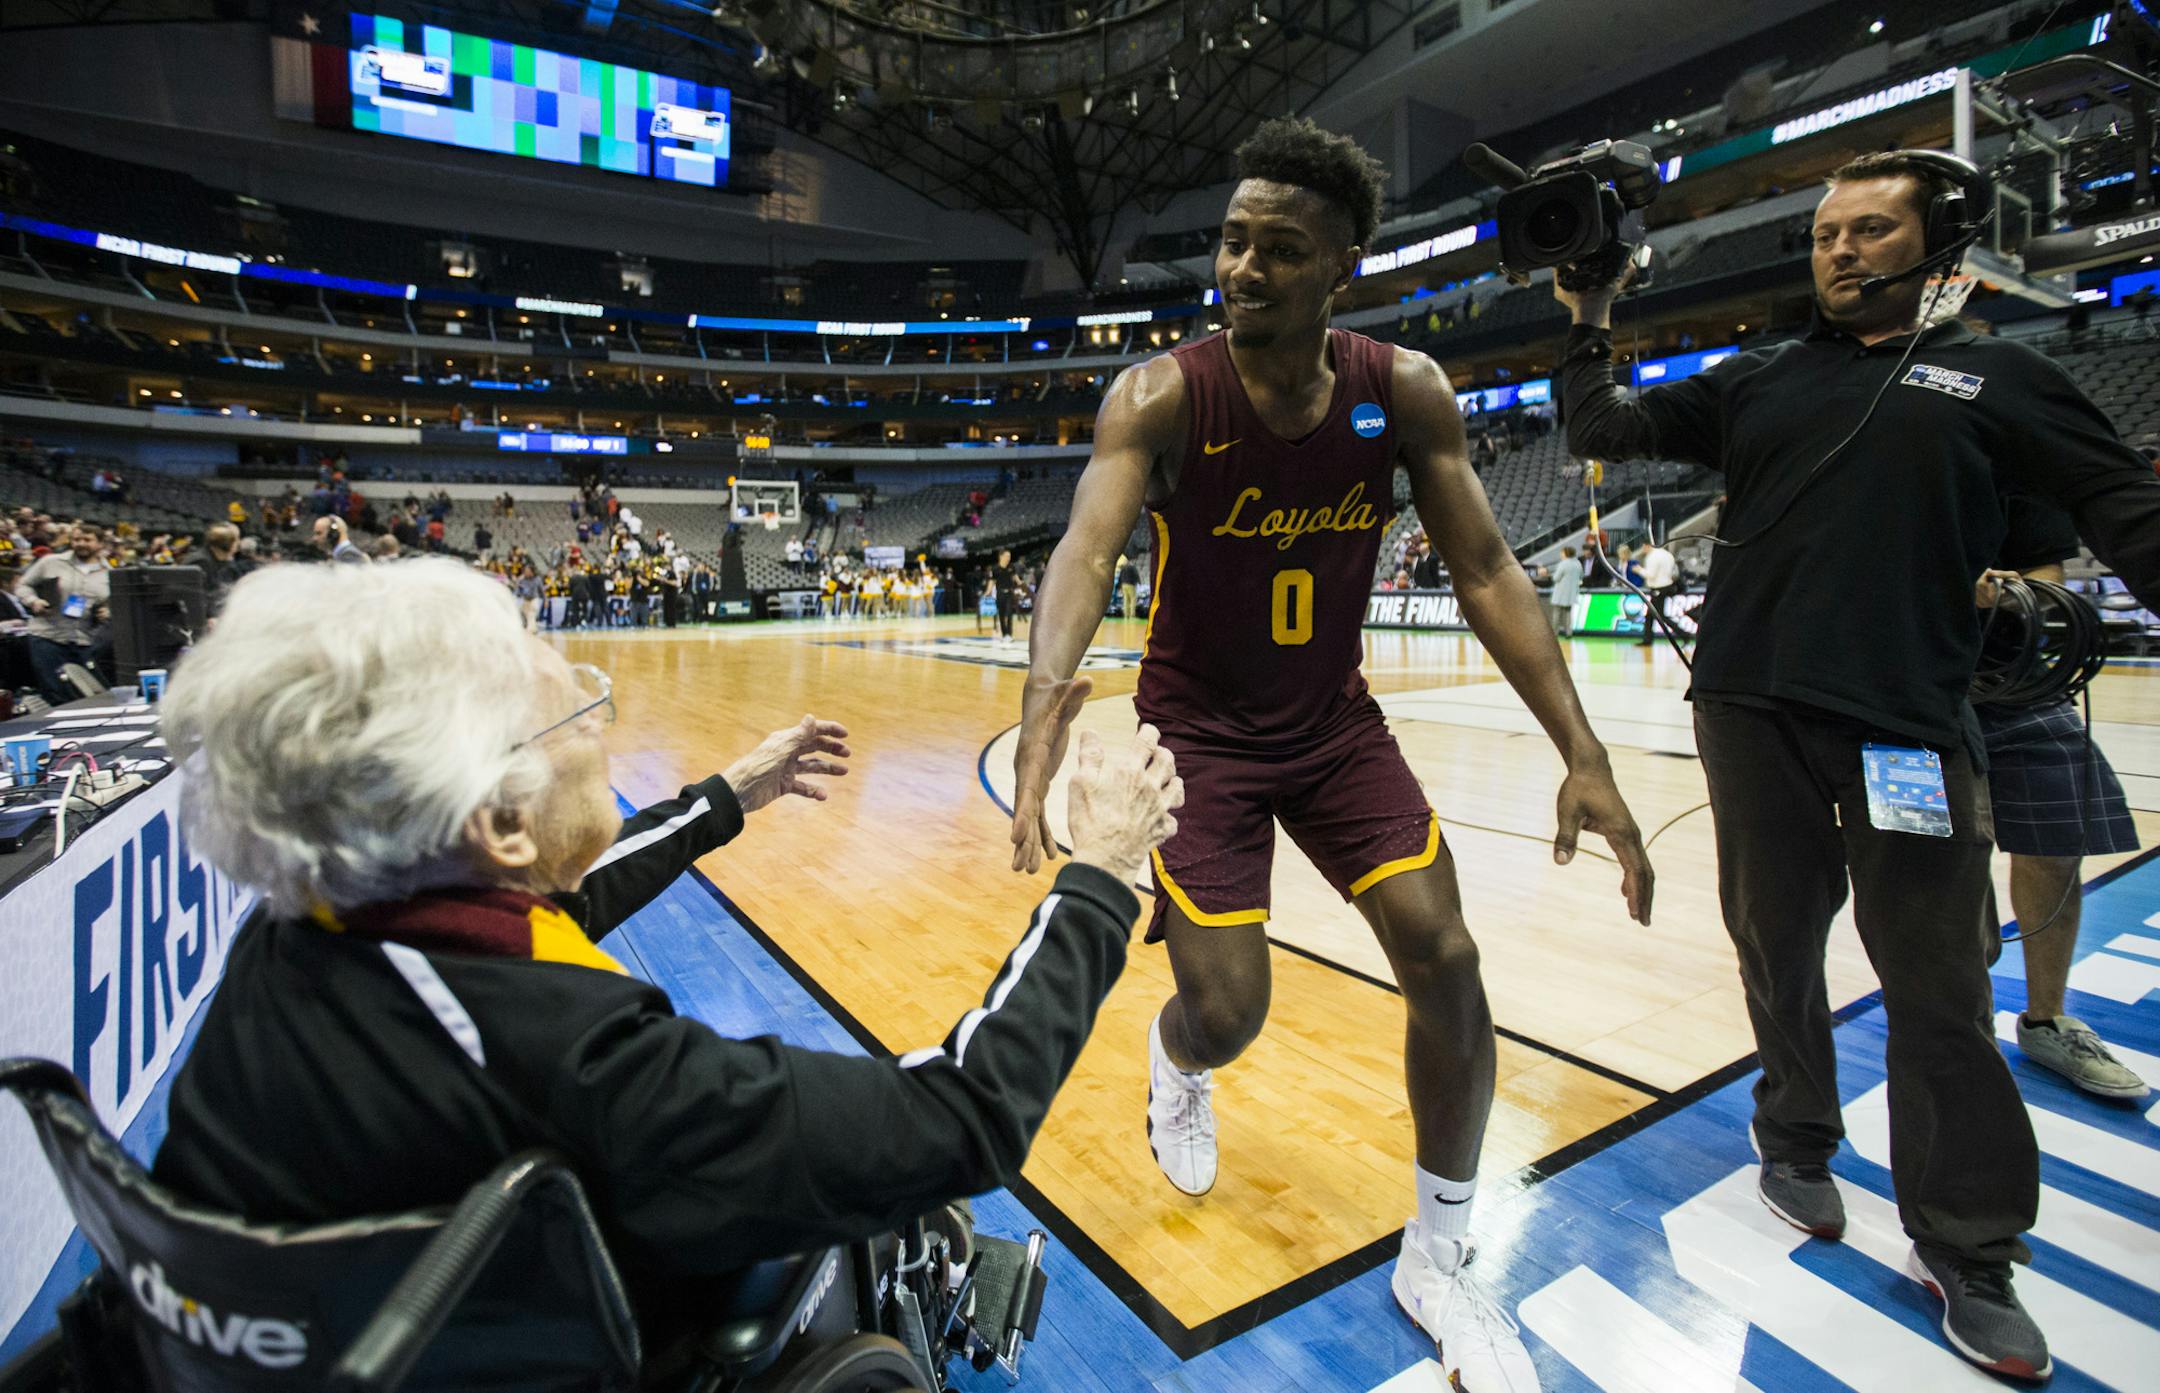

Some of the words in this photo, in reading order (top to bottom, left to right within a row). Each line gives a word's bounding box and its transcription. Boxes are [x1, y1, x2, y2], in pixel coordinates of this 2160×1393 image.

[1772, 67, 1958, 144] #MARCHMADNESS
[1361, 251, 1397, 276] NCAA
[1397, 239, 1433, 268] FIRST
[1430, 225, 1477, 257] ROUND
[844, 322, 872, 336] FIRST
[1925, 367, 1964, 381] MARCH
[1926, 374, 1977, 393] MADNESS
[1356, 417, 1385, 430] NCAA
[1212, 481, 1377, 550] Loyola
[1271, 568, 1314, 646] 0
[1369, 596, 1405, 623] THE
[1405, 596, 1460, 624] FINAL
[131, 1262, 308, 1368] drive
[799, 1259, 836, 1335] drive
